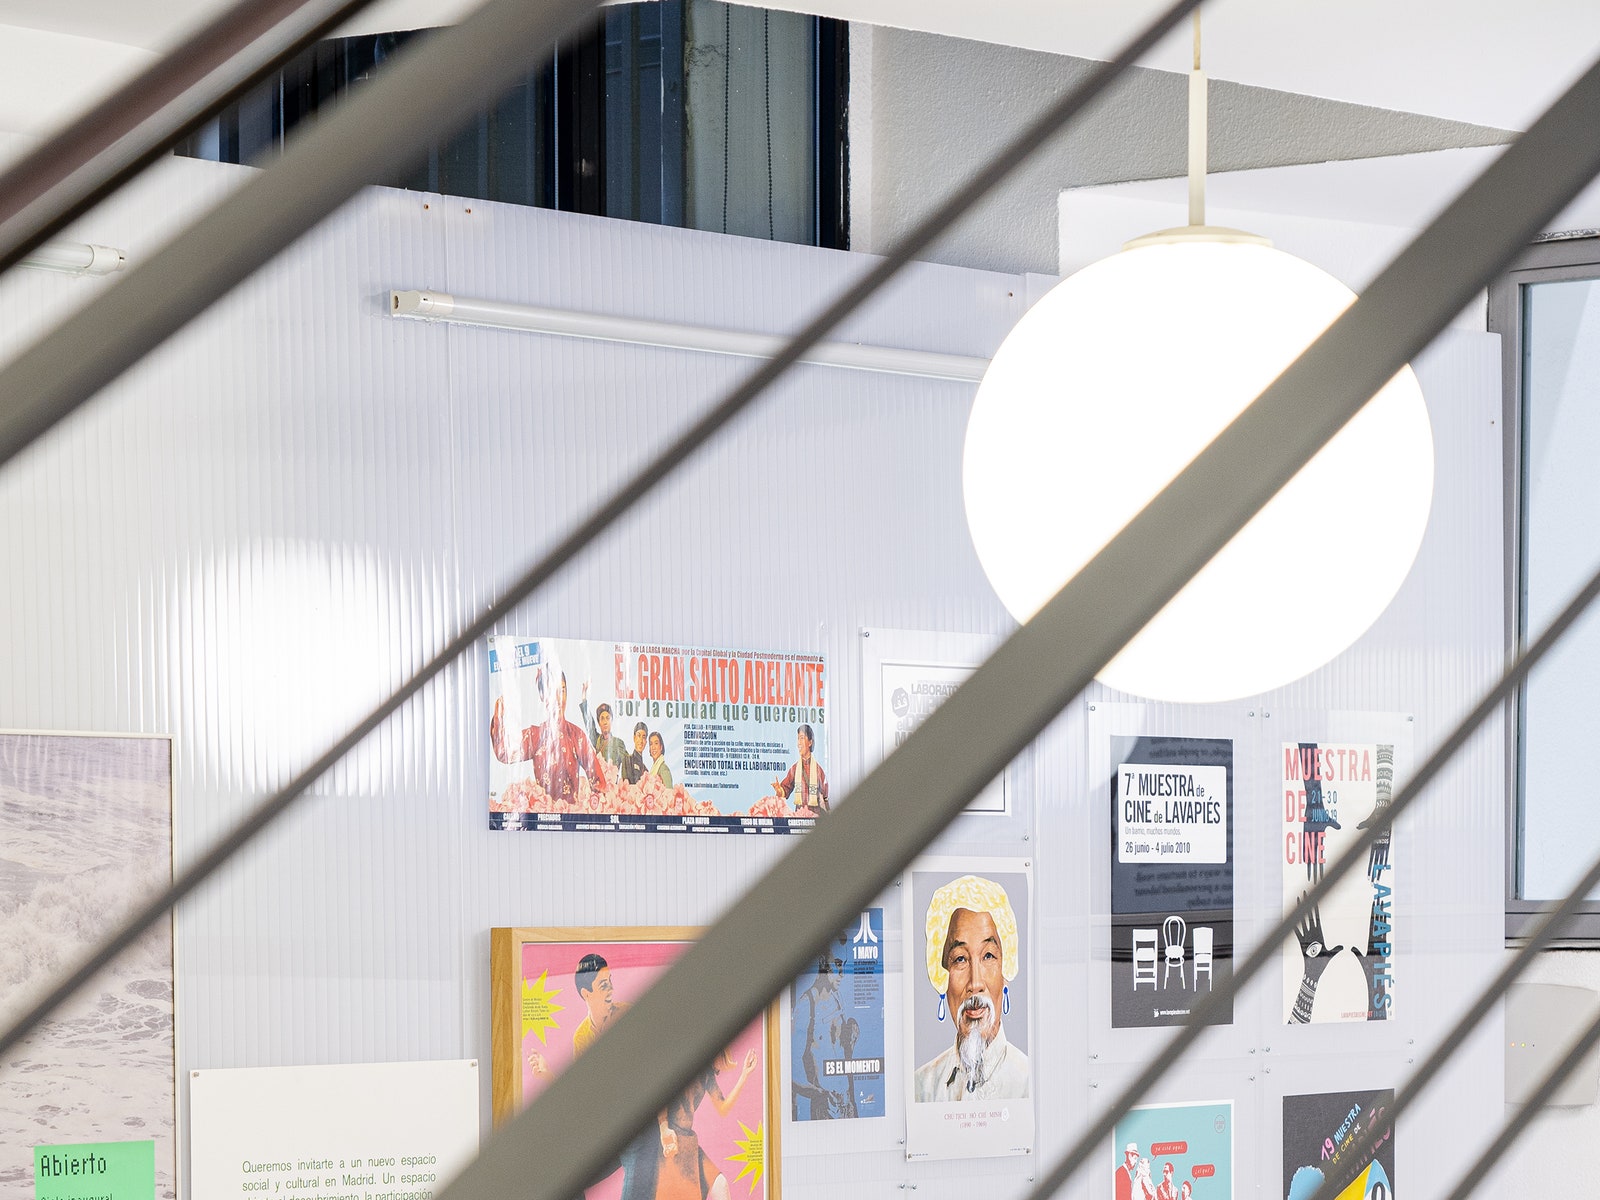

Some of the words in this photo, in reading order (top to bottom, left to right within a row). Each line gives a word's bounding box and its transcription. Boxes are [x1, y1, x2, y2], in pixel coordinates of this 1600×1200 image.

[615, 653, 634, 699] EL
[638, 654, 684, 701] GRAN
[690, 656, 739, 704] SALTO
[744, 661, 824, 707] ADELANTE
[646, 698, 660, 718] la
[666, 700, 717, 720] ciudad
[722, 703, 749, 723] que
[755, 704, 824, 724] queremos
[684, 760, 716, 769] ENCUENTRO
[717, 760, 734, 770] TOTAL
[735, 761, 741, 769] EN
[743, 761, 748, 770] EL
[750, 761, 786, 771] LABORATORIO
[1285, 748, 1371, 781] MUESTRA
[1139, 773, 1194, 796] MUESTRA
[1196, 785, 1204, 797] de
[1311, 790, 1338, 804] 21-30
[1125, 800, 1151, 823] CINE
[1154, 811, 1162, 823] de
[1165, 796, 1220, 824] LAVAPIÉS
[1286, 790, 1307, 822] DE
[1125, 827, 1131, 835] Un
[1147, 827, 1163, 835] muchos
[1126, 842, 1133, 853] 26
[1134, 842, 1149, 855] junio
[1156, 842, 1159, 852] 4
[1161, 842, 1174, 855] julio
[1176, 842, 1190, 853] 2010
[1286, 832, 1326, 864] CINE
[1373, 864, 1395, 1010] LAVAPIÉS
[853, 947, 856, 959] 1
[858, 946, 878, 959] MAYO
[826, 1062, 835, 1074] ES
[836, 1061, 843, 1074] EL
[845, 1060, 880, 1073] MOMENTO
[1322, 1138, 1335, 1160] 19
[1334, 1104, 1361, 1145] MUESTRA
[1332, 1152, 1340, 1164] DE
[1341, 1134, 1354, 1152] CINE
[40, 1153, 107, 1177] Abierto
[242, 1160, 292, 1174] Queremos
[298, 1158, 333, 1170] invitarte
[339, 1159, 345, 1169] a
[351, 1158, 362, 1168] un
[368, 1156, 396, 1167] nuevo
[401, 1153, 436, 1169] espacio
[242, 1179, 269, 1191] social
[275, 1181, 280, 1193] y
[286, 1176, 319, 1189] cultural
[325, 1177, 336, 1187] en
[343, 1173, 376, 1186] Madrid.
[383, 1172, 395, 1184] Un
[401, 1171, 436, 1186] espacio
